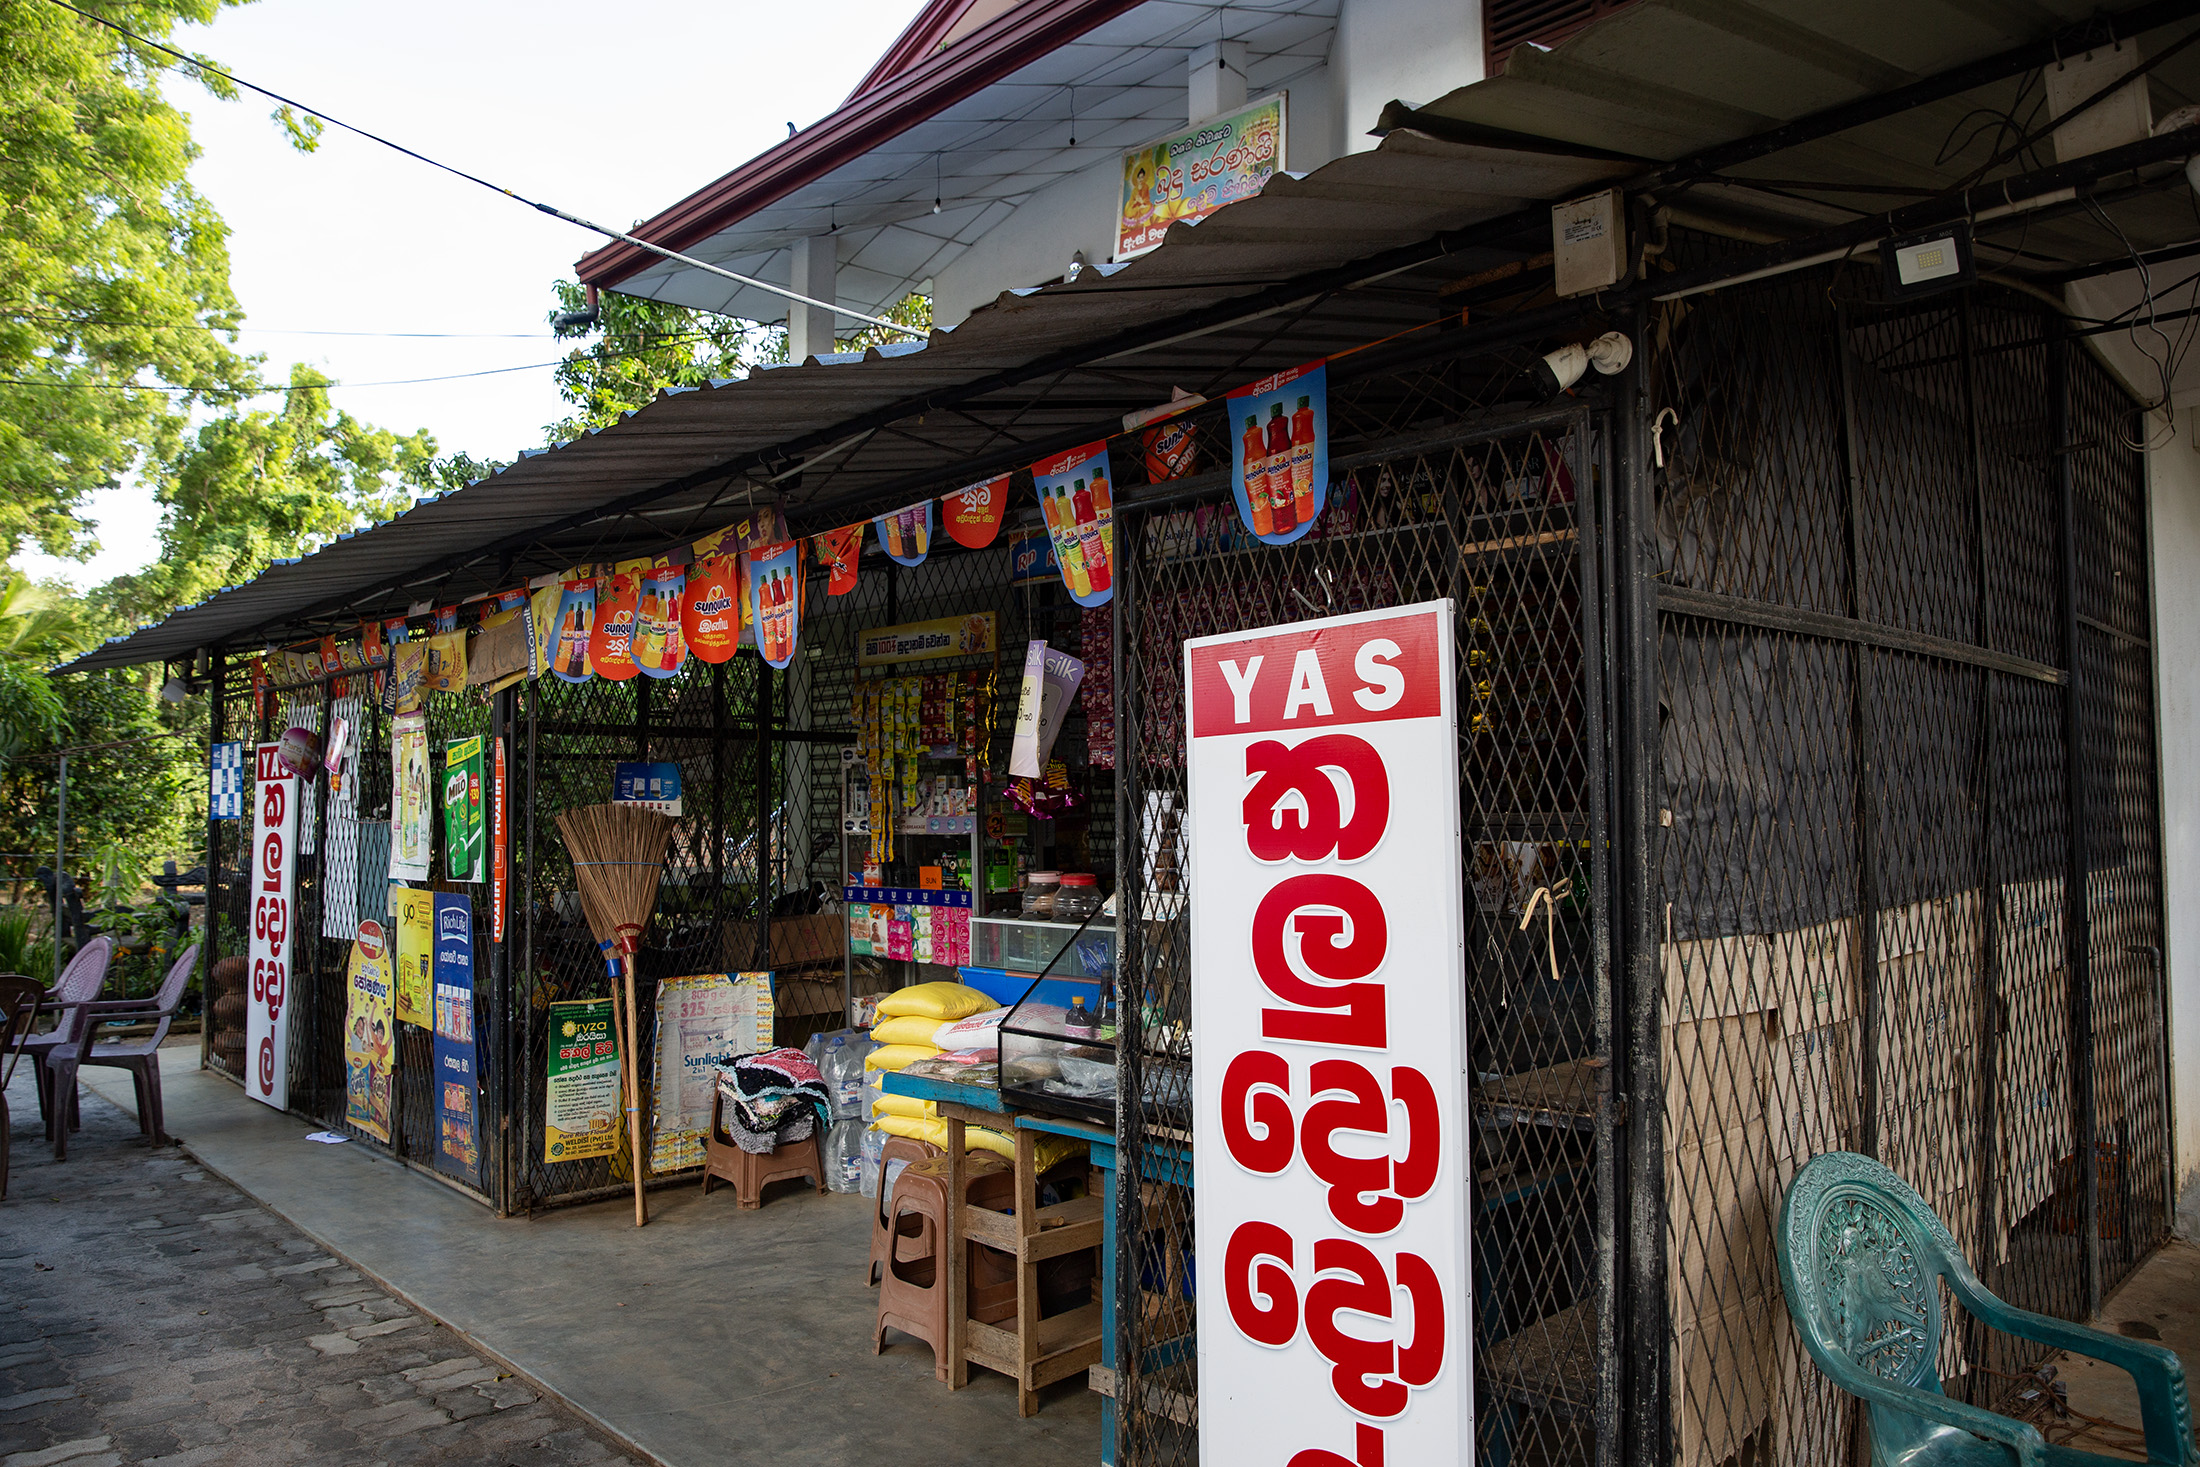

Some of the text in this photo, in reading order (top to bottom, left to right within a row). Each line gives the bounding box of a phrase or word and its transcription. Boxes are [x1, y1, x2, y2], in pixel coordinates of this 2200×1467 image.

[1154, 130, 1274, 205] බුදු සරණයි
[1017, 548, 1037, 572] Rin
[693, 596, 732, 613] SUNQUICK
[603, 622, 632, 635] SUNQU
[1028, 644, 1042, 666] silk
[1045, 656, 1078, 683] silk
[1218, 638, 1405, 725] YAS
[448, 779, 466, 801] MILO
[925, 877, 937, 885] SUN
[443, 914, 467, 932] RichLife
[691, 990, 709, 1001] 800
[595, 1040, 614, 1056] පිටි
[575, 1130, 589, 1138] Rice
